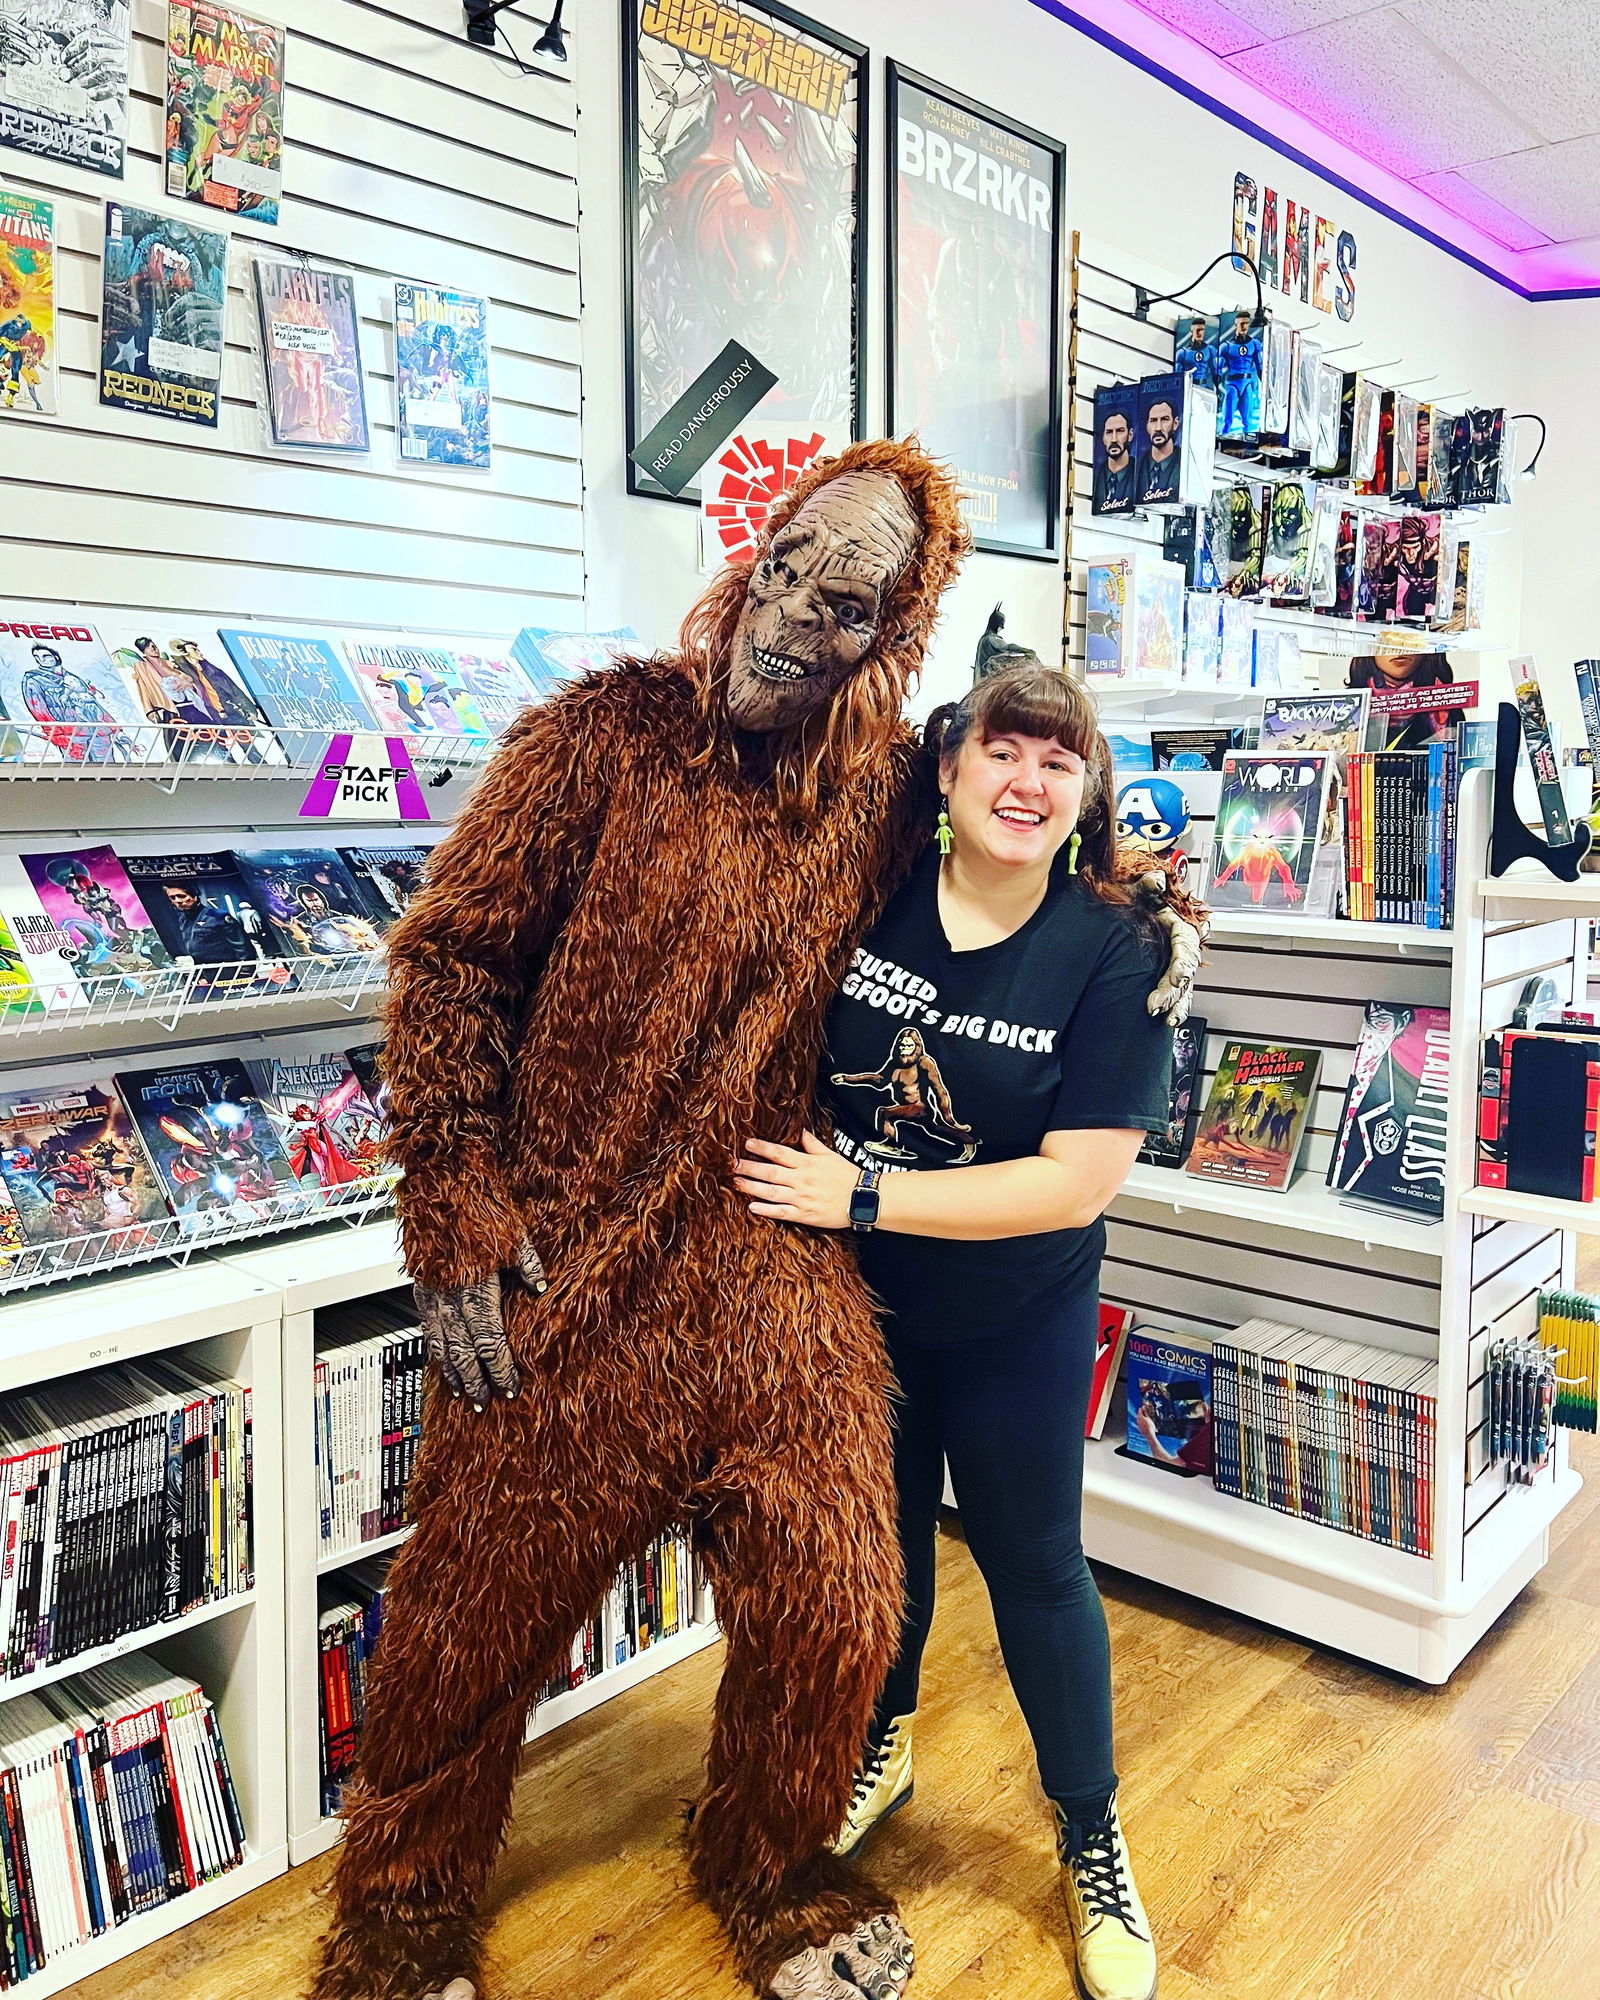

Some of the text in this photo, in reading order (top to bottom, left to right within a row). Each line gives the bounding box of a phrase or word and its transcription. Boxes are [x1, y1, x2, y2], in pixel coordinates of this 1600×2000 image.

[221, 22, 254, 50] Ms.
[192, 33, 274, 80] MARVEL
[641, 0, 850, 120] JUGGERNAUT
[922, 111, 971, 141] RON GARNEY
[925, 97, 980, 132] KEANU REEVES
[0, 105, 121, 170] REDNECK
[994, 145, 1032, 168] CRABTREE
[898, 116, 1051, 233] BRZRKR
[1231, 171, 1358, 322] GAMES
[103, 369, 216, 419] REDNECK
[652, 358, 753, 473] READ DANGEROUSLY
[997, 477, 1018, 492] FROM
[1143, 487, 1173, 501] Select
[1460, 487, 1495, 500] THOR
[1100, 497, 1129, 511] Select
[288, 641, 329, 664] CLASS
[356, 643, 456, 675] INVINCIBLE
[1416, 689, 1431, 697] AND
[1277, 697, 1354, 725] BACKWAYS
[322, 765, 409, 783] STAFF
[1238, 763, 1316, 789] WORLD
[342, 785, 389, 803] PICK
[129, 860, 223, 875] GALACTICA
[160, 870, 198, 879] ORIGINS
[13, 914, 56, 935] BLACK
[21, 931, 74, 955] SCIENCE
[850, 946, 938, 1002] SUCKED
[940, 1014, 988, 1040] BIG
[987, 1019, 1058, 1053] DICK
[1233, 1061, 1305, 1085] HAMMER
[1239, 1050, 1288, 1068] BLACK
[272, 1060, 343, 1094] AVENGERS
[1247, 1075, 1282, 1085] OMNIBUS
[16, 1104, 41, 1114] FORTNITE
[64, 1104, 109, 1120] WAR
[1399, 1114, 1448, 1187] CLASS
[1391, 1185, 1441, 1202] NOISE NOISE NOISE
[109, 1345, 120, 1355] HE
[1129, 1340, 1154, 1356] 1001
[1156, 1347, 1208, 1371] COMICS
[382, 1379, 392, 1431] FEAR AGENT
[394, 1375, 403, 1428] FEAR AGENT
[404, 1370, 414, 1437] FEAR AGENT 2
[414, 1368, 423, 1421] FEAR AGENT
[10, 1463, 23, 1493] MARVEL
[4, 1553, 15, 1580] FIRSTS
[9, 1879, 20, 1918] RIVERDALE
